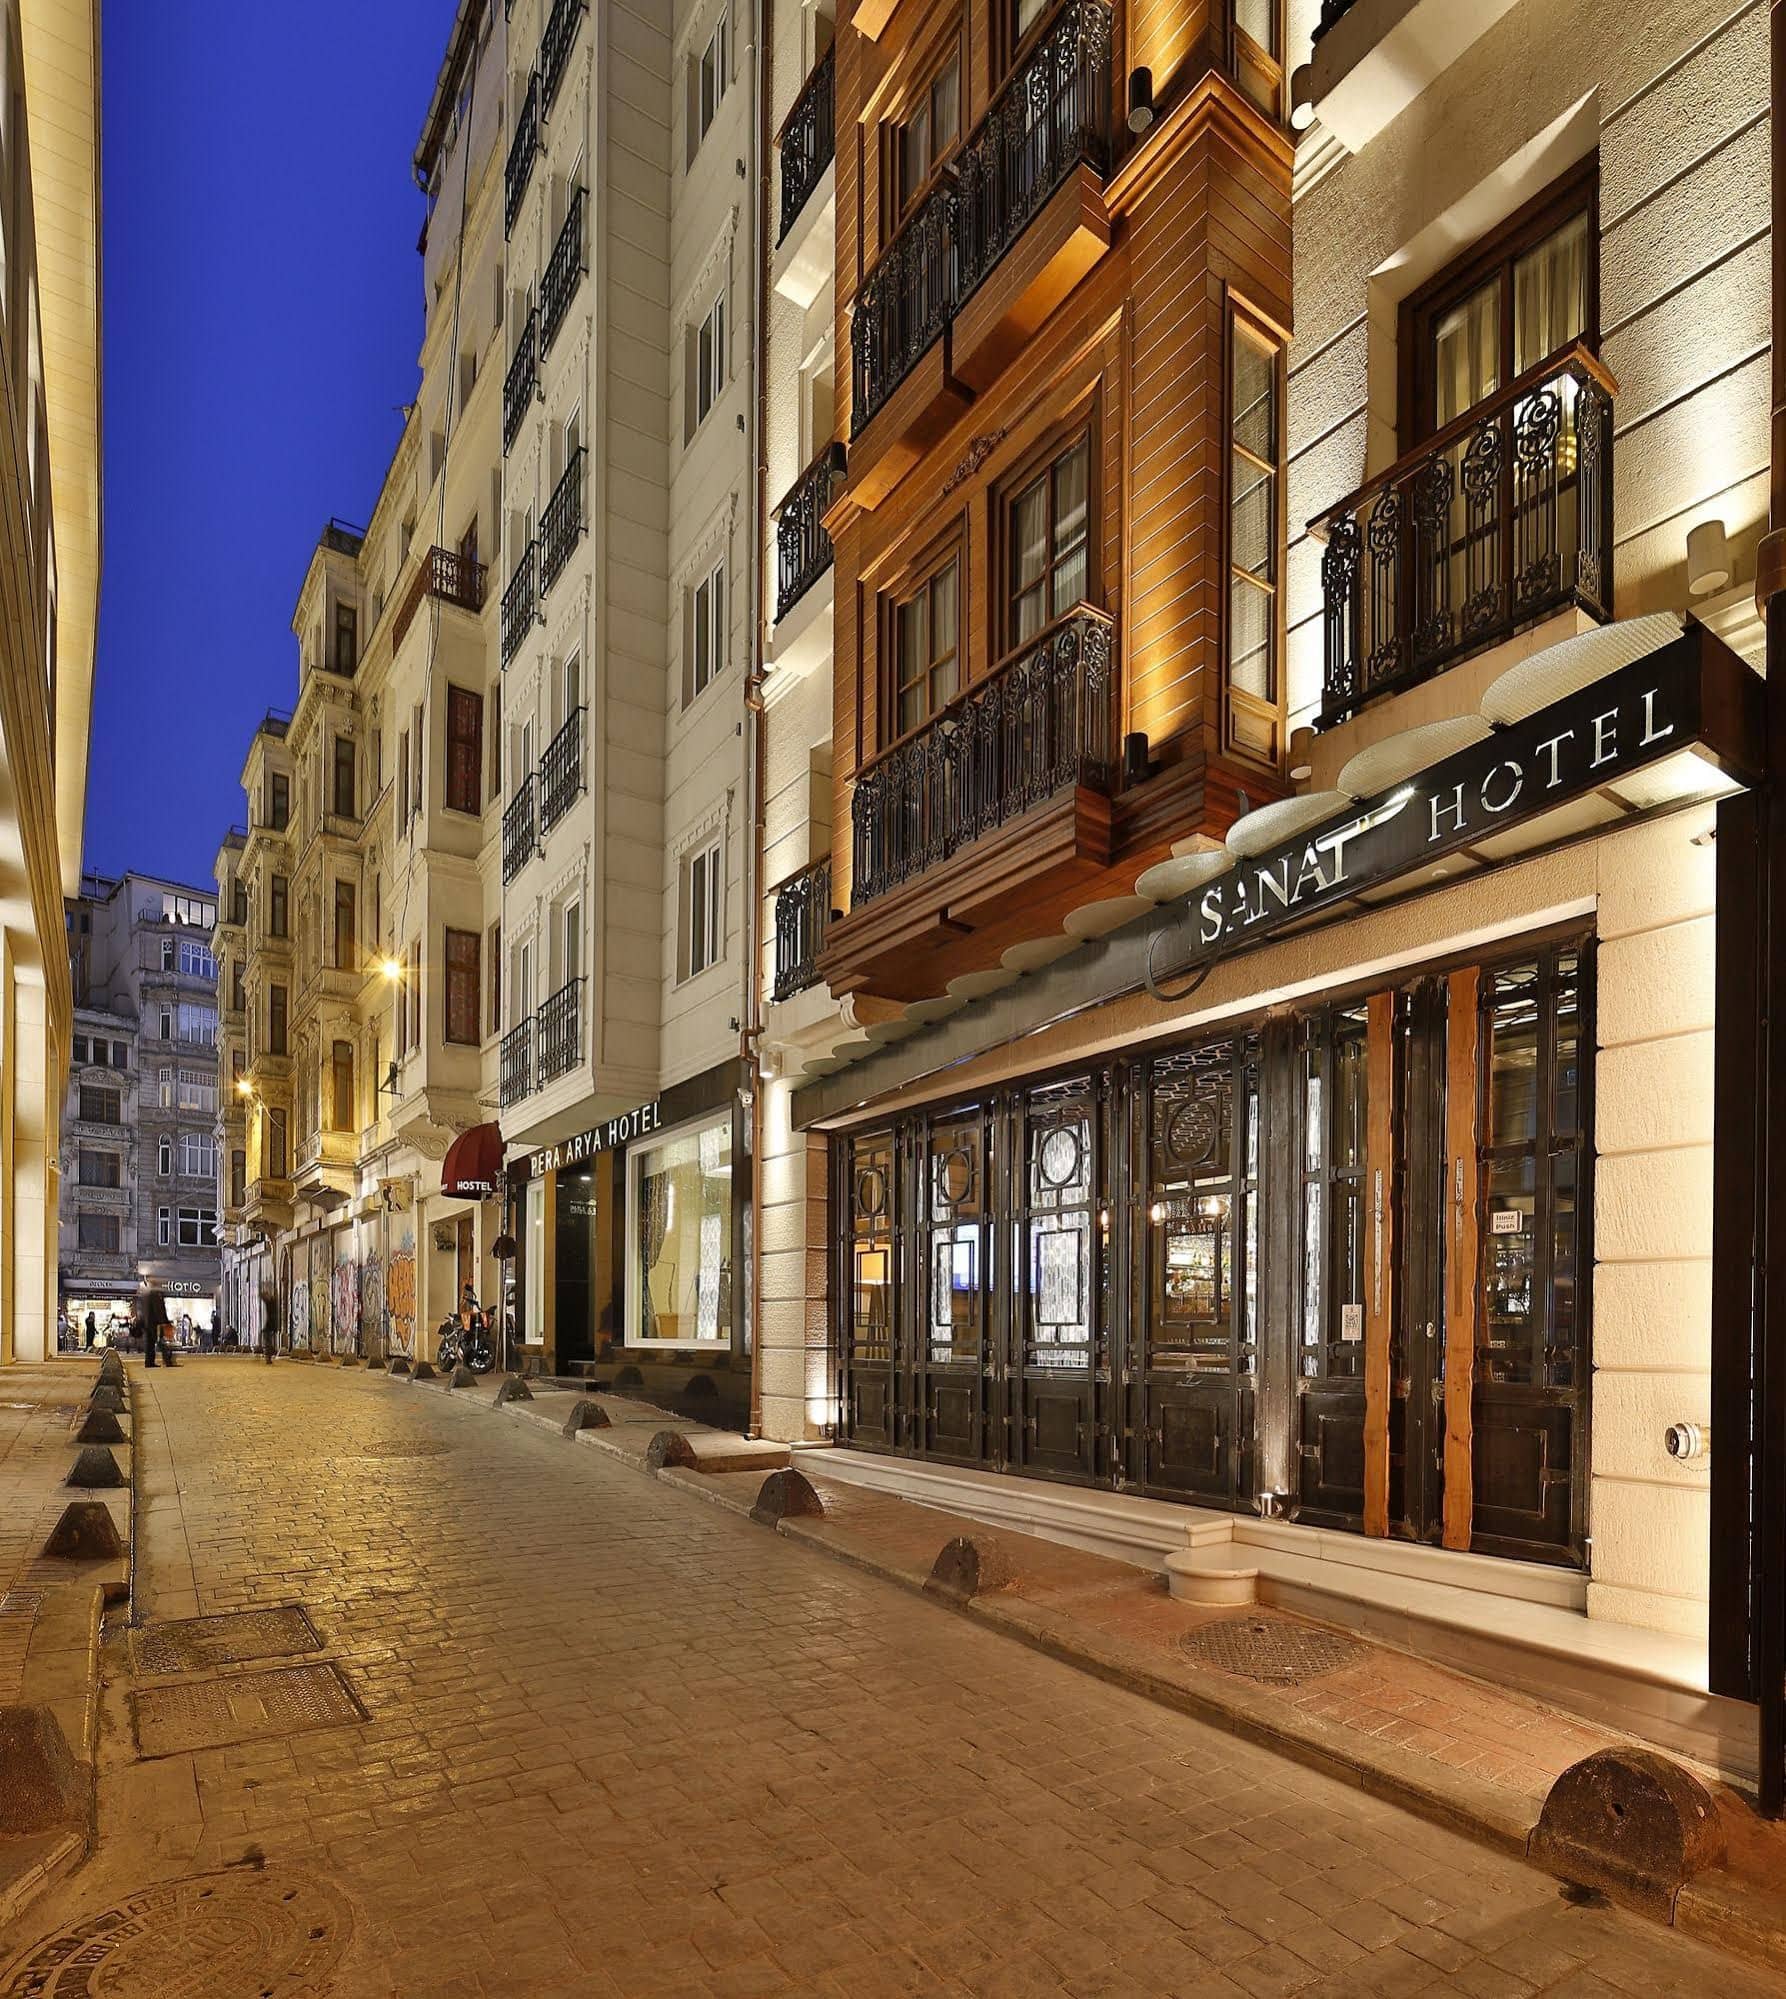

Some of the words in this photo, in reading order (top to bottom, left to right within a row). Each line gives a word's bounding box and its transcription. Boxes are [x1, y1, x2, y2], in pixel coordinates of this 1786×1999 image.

[1199, 787, 1415, 945] SANAT
[1427, 688, 1675, 842] HOTEL
[530, 1146, 561, 1178] PERA
[566, 1127, 602, 1164] ARYA
[608, 1101, 662, 1146] HOTEL
[457, 1181, 493, 1192] HOSTEL
